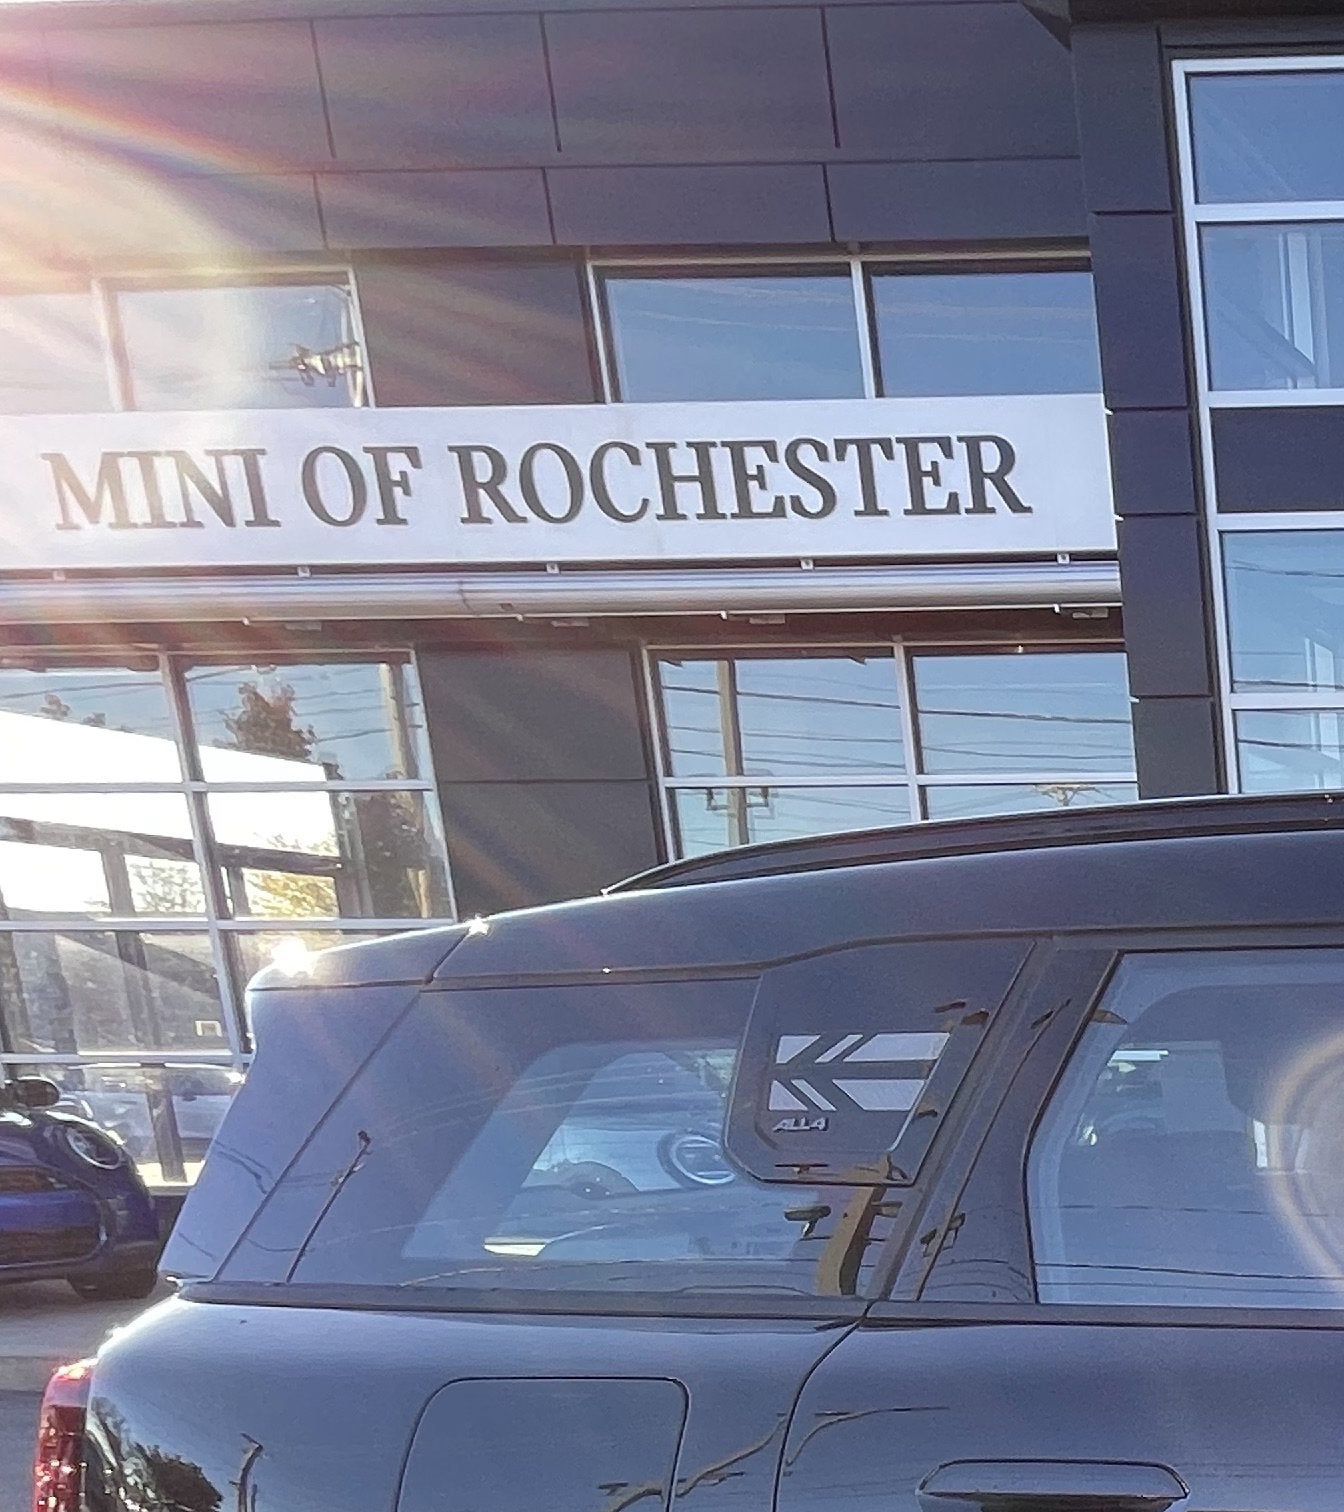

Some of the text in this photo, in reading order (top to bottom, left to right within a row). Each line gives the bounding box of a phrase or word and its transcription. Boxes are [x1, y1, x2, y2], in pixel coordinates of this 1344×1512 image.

[40, 434, 1034, 531] MINI OF ROCHESTER
